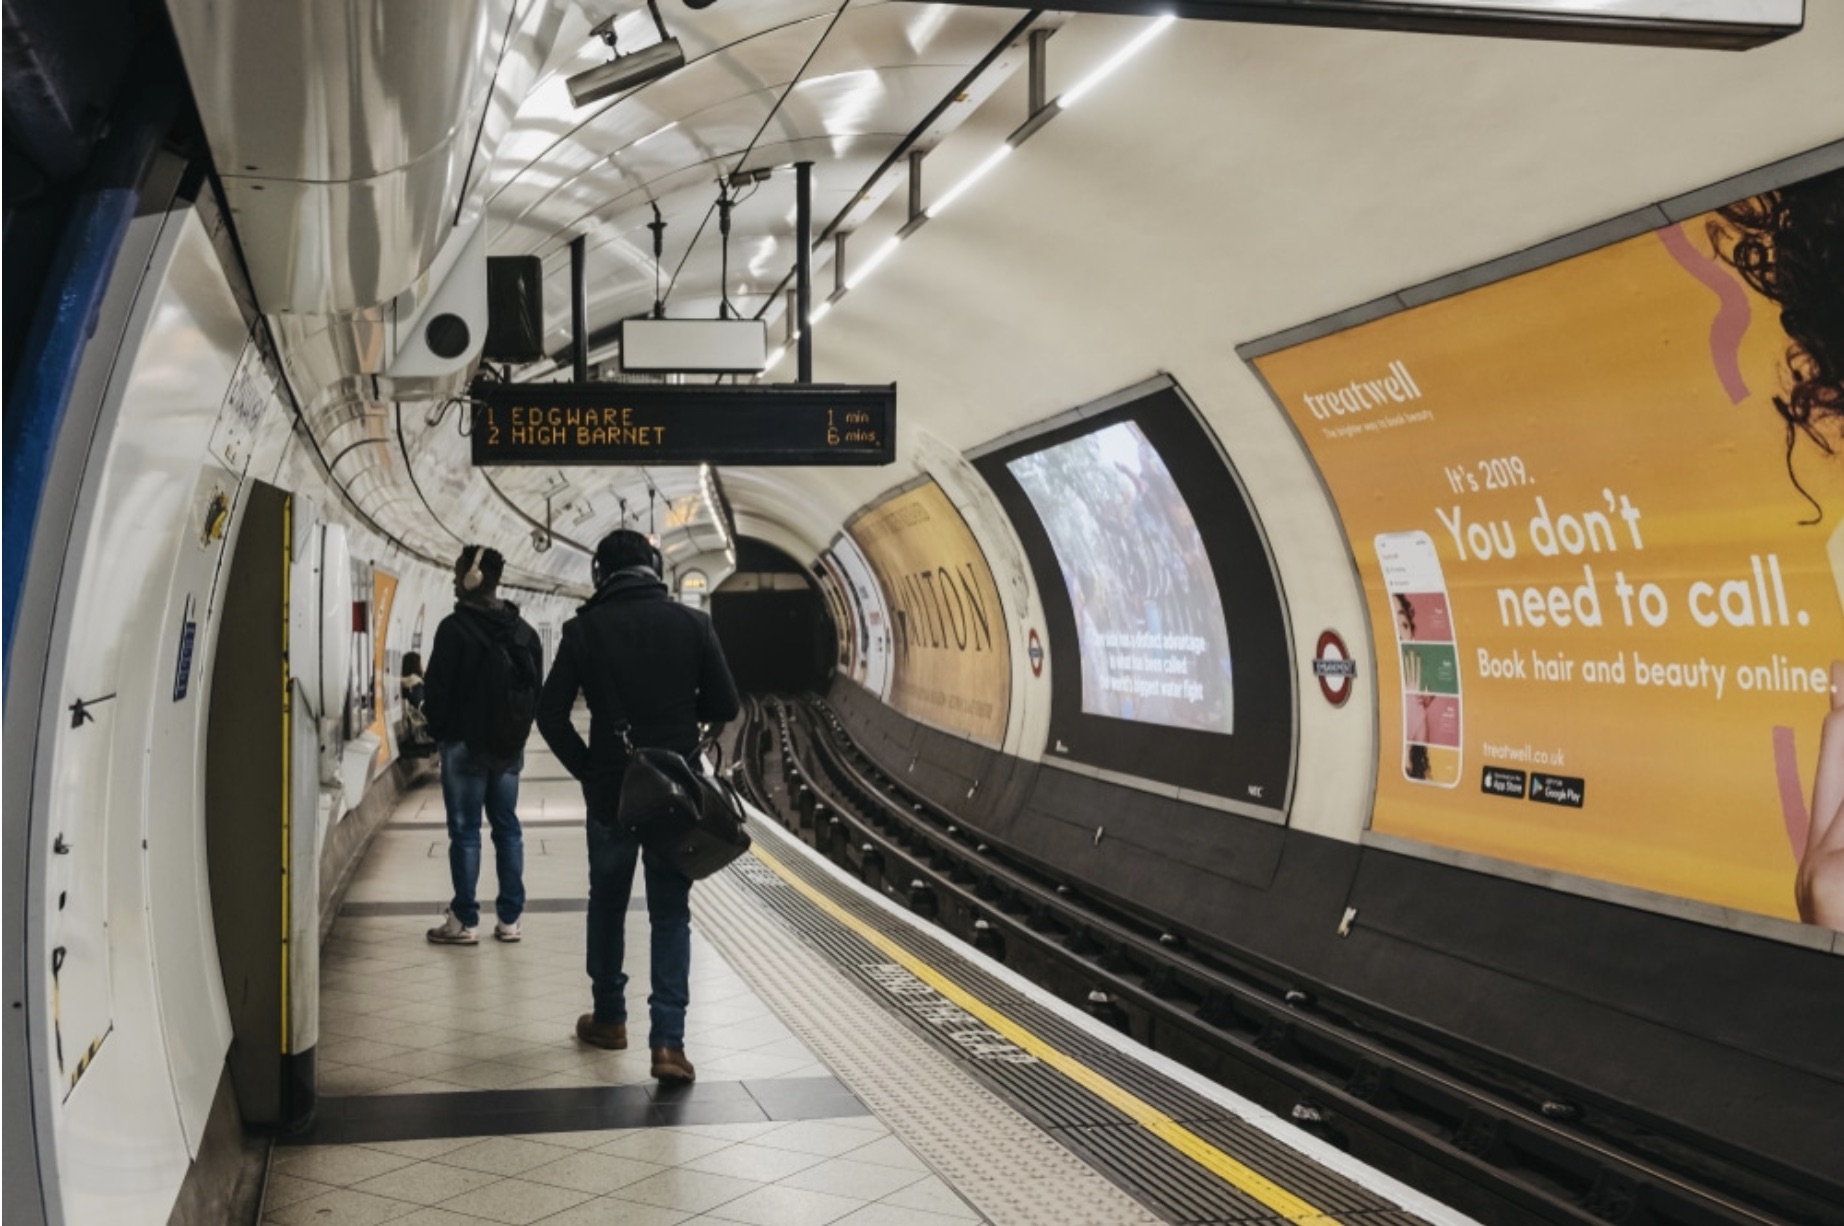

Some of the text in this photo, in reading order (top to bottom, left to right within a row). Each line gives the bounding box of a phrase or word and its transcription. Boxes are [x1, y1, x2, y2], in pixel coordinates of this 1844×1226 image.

[1303, 359, 1422, 420] treatwell
[488, 407, 869, 426] 1 EDGWARE 1 min
[488, 426, 499, 444] 2
[512, 426, 566, 445] HIGH
[576, 426, 665, 445] BARNET
[827, 426, 840, 445] 6
[1444, 455, 1536, 495] It's 2019.
[1436, 488, 1645, 562] You don't
[1497, 564, 1602, 628] need
[1616, 571, 1668, 628] to
[1687, 553, 1811, 628] call.
[1477, 649, 1527, 681] Book
[1532, 647, 1575, 683] hair
[1582, 651, 1626, 686] and
[1634, 650, 1727, 700] beauty
[1736, 653, 1838, 693] online.
